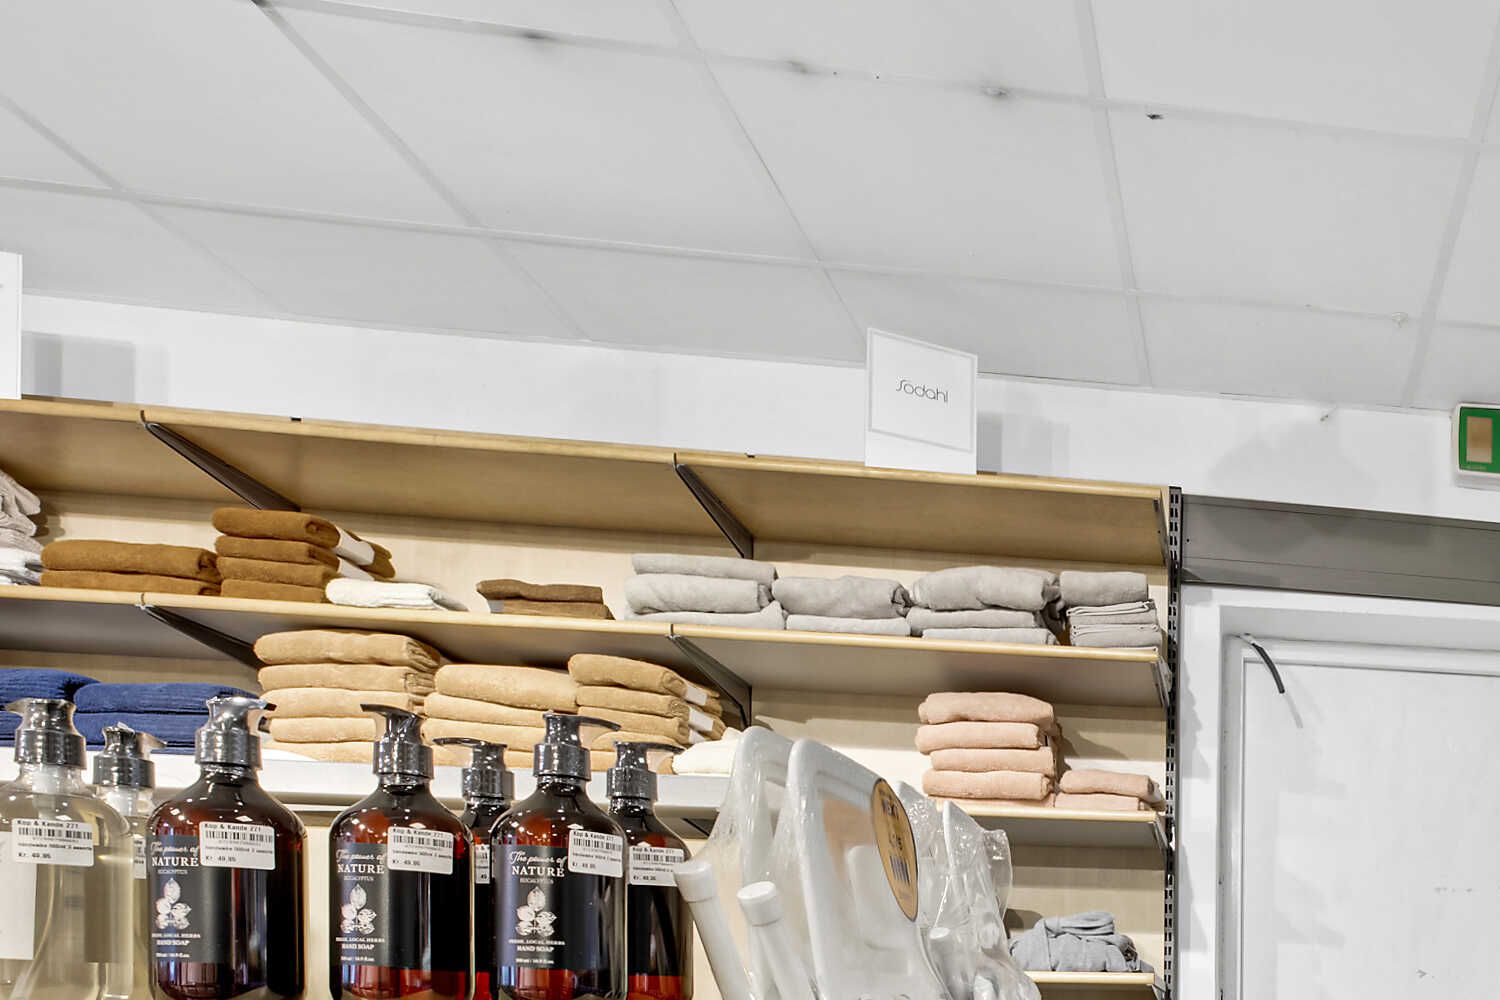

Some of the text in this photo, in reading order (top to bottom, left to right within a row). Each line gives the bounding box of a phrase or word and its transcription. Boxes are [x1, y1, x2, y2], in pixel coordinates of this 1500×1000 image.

[152, 856, 199, 867] NATURE
[509, 851, 528, 863] The
[527, 854, 554, 866] power
[556, 856, 567, 868] of
[337, 864, 385, 875] NATURE
[511, 866, 566, 877] NATURE
